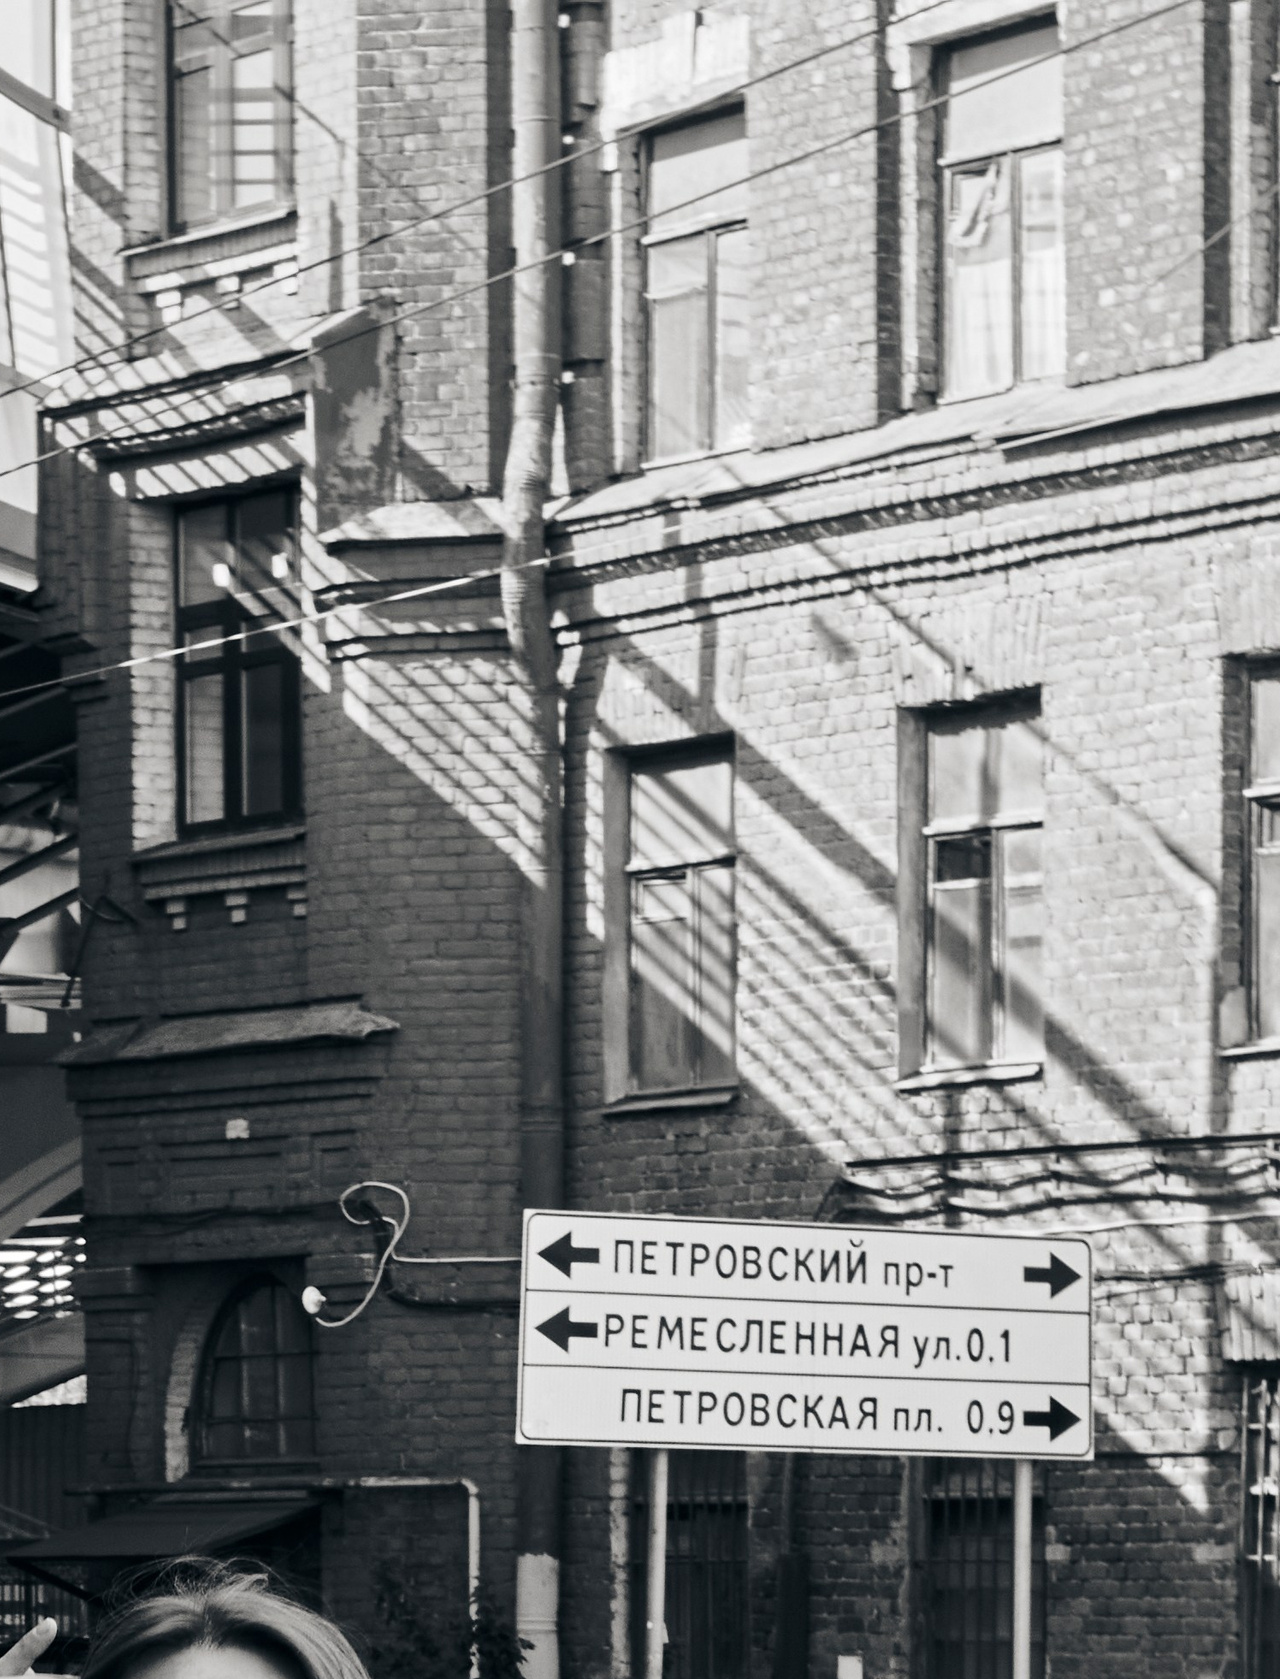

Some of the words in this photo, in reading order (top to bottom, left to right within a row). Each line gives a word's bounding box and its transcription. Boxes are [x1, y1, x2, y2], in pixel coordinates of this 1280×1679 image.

[614, 1238, 867, 1285] ПЕТРОВСКИЙ
[884, 1261, 955, 1296] пр-т
[604, 1313, 899, 1359] РЕМЕСЛЕННАЯ
[620, 1388, 878, 1431] ПЕТРОВСКАЯ
[893, 1407, 943, 1433] пл.
